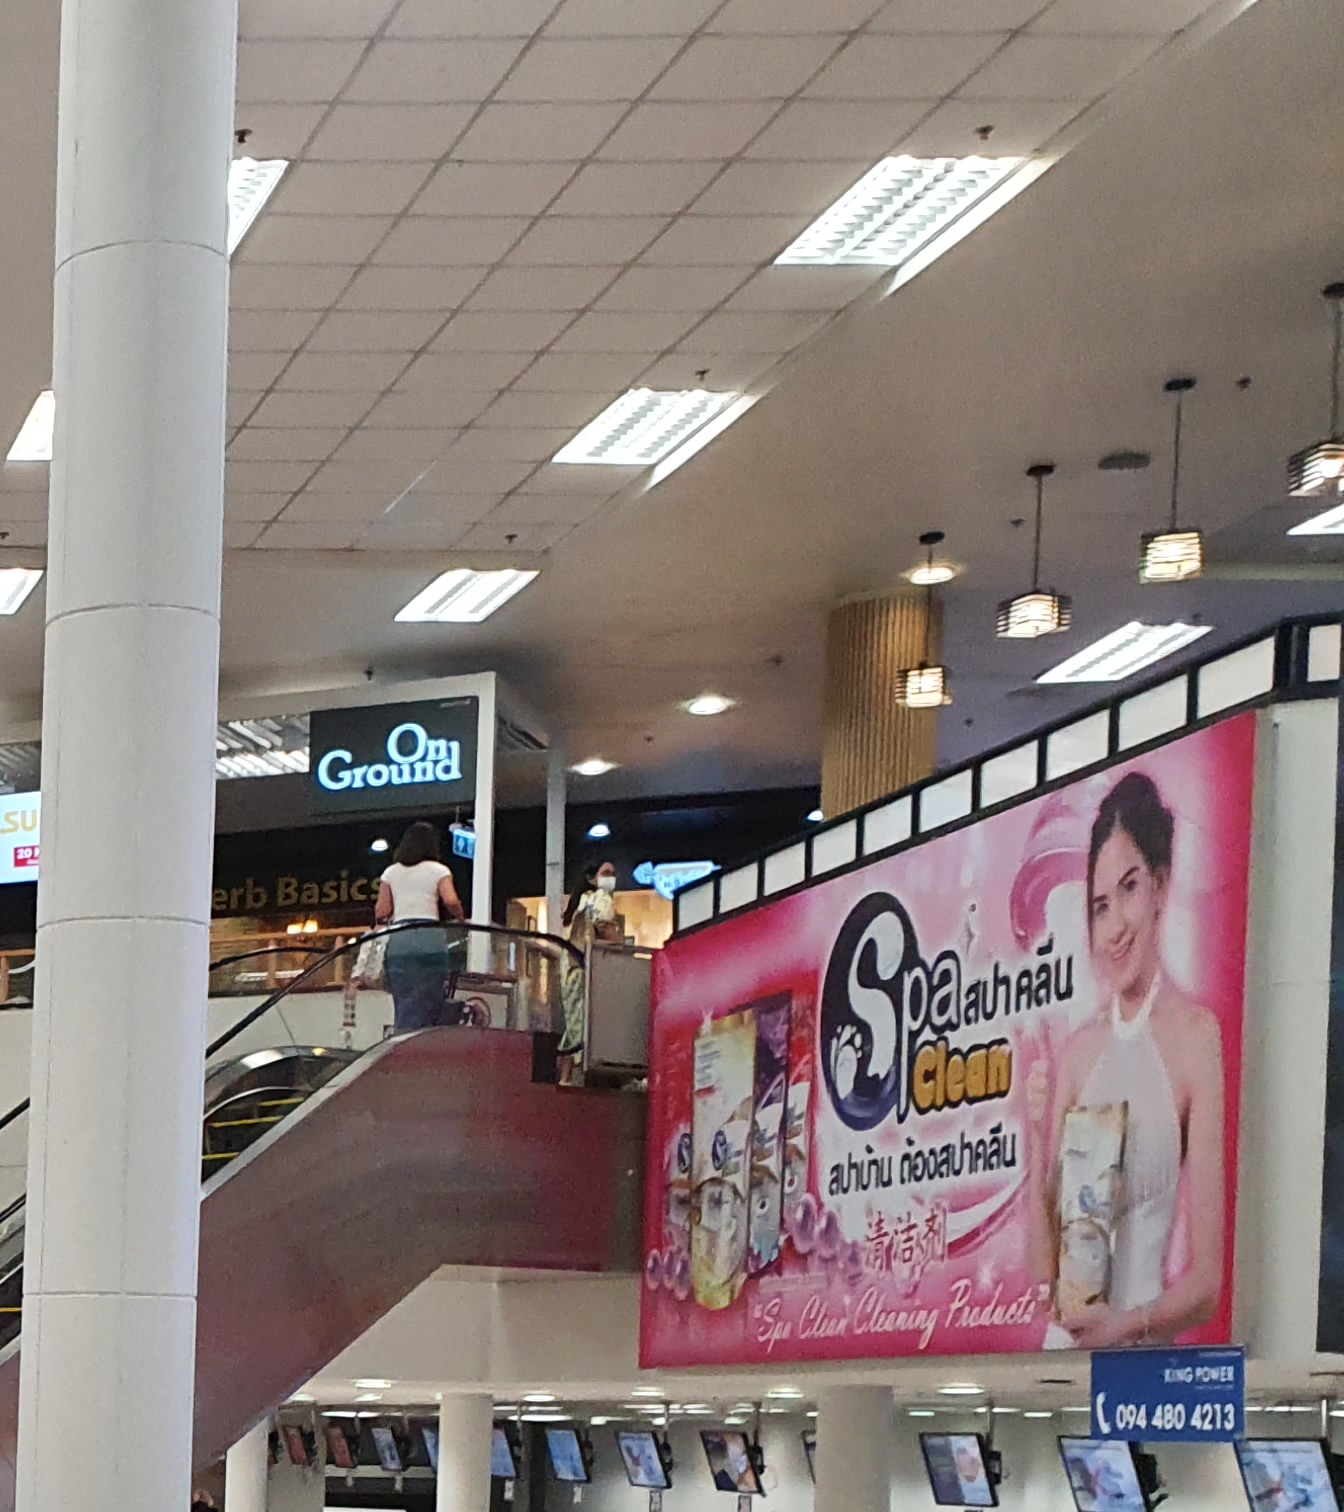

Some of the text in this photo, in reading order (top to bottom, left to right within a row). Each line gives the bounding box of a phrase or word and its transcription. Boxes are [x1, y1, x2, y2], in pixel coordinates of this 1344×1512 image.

[318, 741, 462, 790] Ground
[387, 723, 447, 763] On
[212, 869, 381, 912] erb Basics
[846, 906, 962, 1122] Spa
[912, 1036, 1014, 1115] Clean
[799, 1294, 850, 1340] Clean
[854, 1285, 940, 1351] Cleaning
[1164, 1365, 1234, 1383] KING POWER
[1115, 1402, 1235, 1431] 094 480 4213
